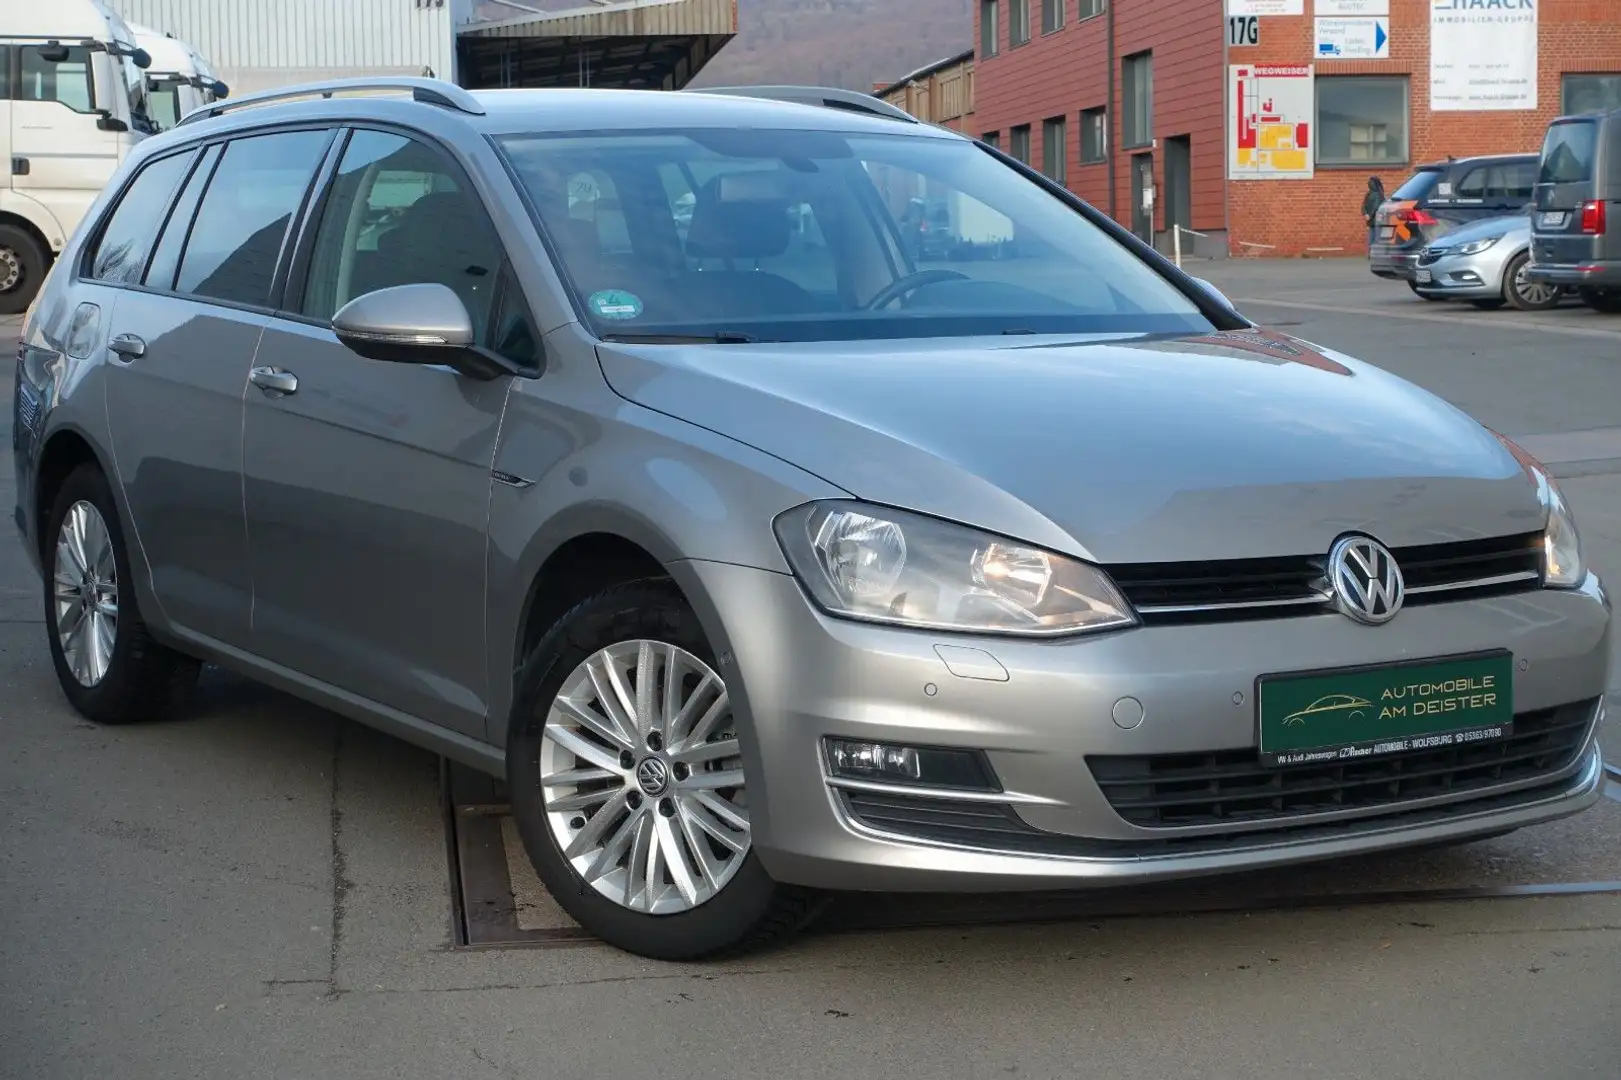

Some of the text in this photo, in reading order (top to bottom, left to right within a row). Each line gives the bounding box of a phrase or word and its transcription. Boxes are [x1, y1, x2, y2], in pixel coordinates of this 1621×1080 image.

[1230, 16, 1258, 44] 17G
[1254, 66, 1309, 75] WEGWEISER
[1380, 675, 1495, 701] AUTOMOBILE
[1378, 693, 1497, 720] AM DEISTER
[1373, 740, 1409, 754] AUTOMOBILE
[1411, 734, 1453, 749] WOLFSBURG
